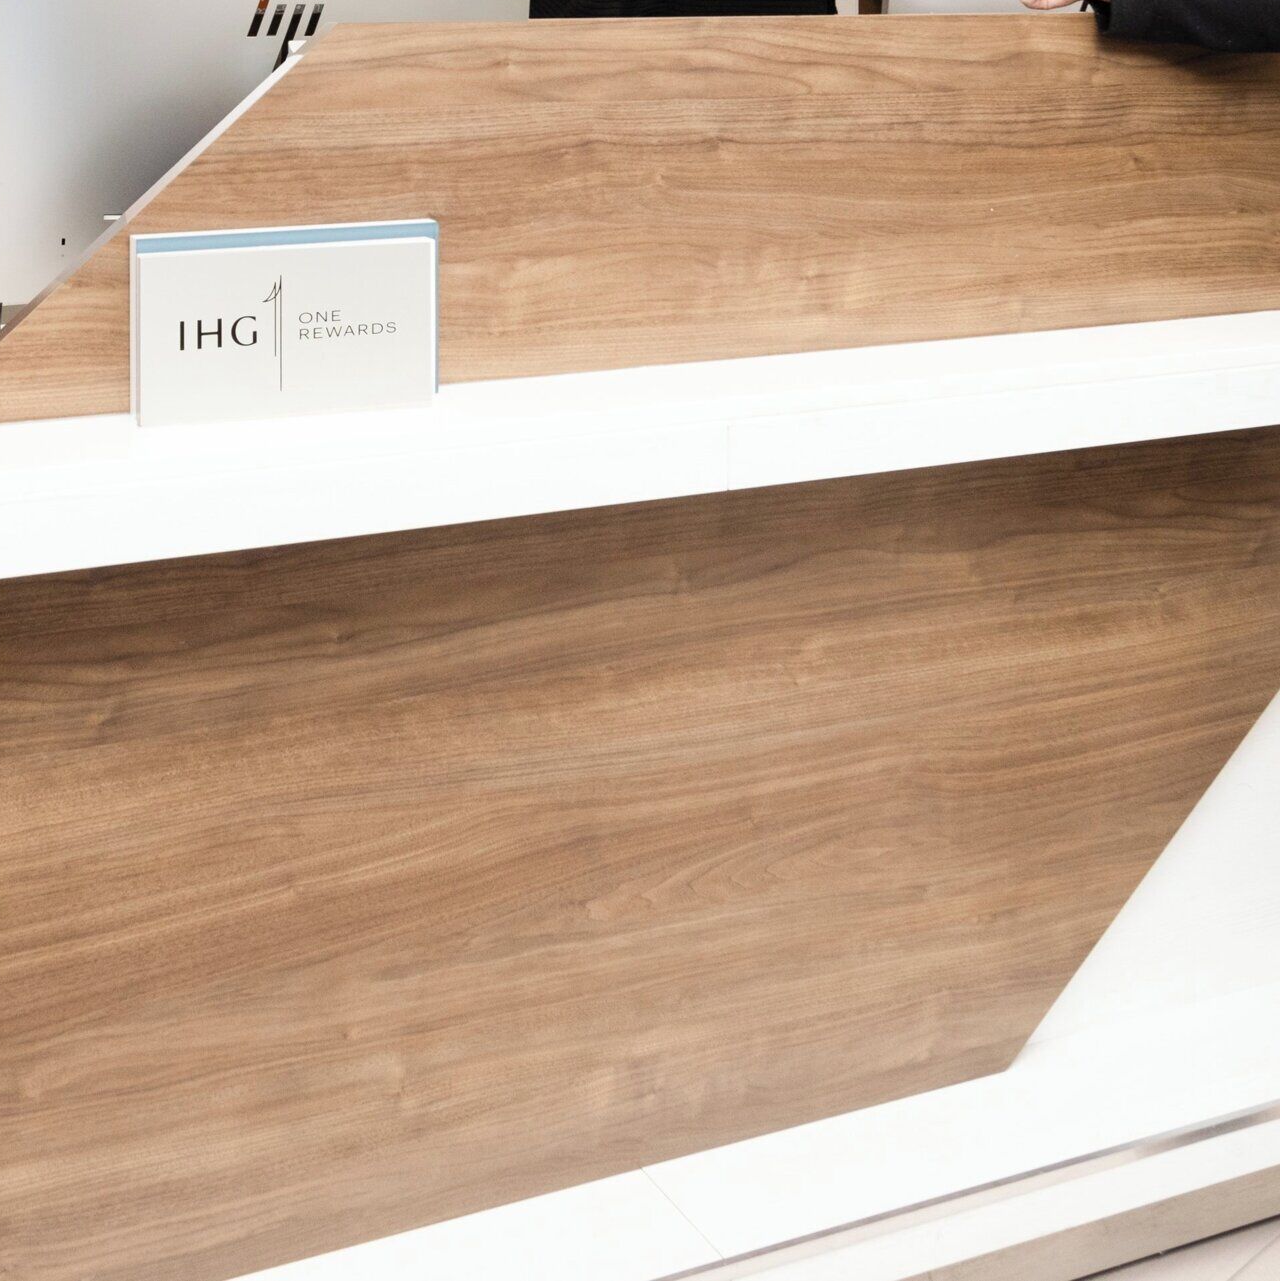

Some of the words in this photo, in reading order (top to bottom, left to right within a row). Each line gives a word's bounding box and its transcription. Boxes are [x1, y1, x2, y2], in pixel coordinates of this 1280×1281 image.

[298, 309, 342, 324] ONE
[179, 315, 258, 351] IHG
[298, 321, 398, 340] REWARDS
